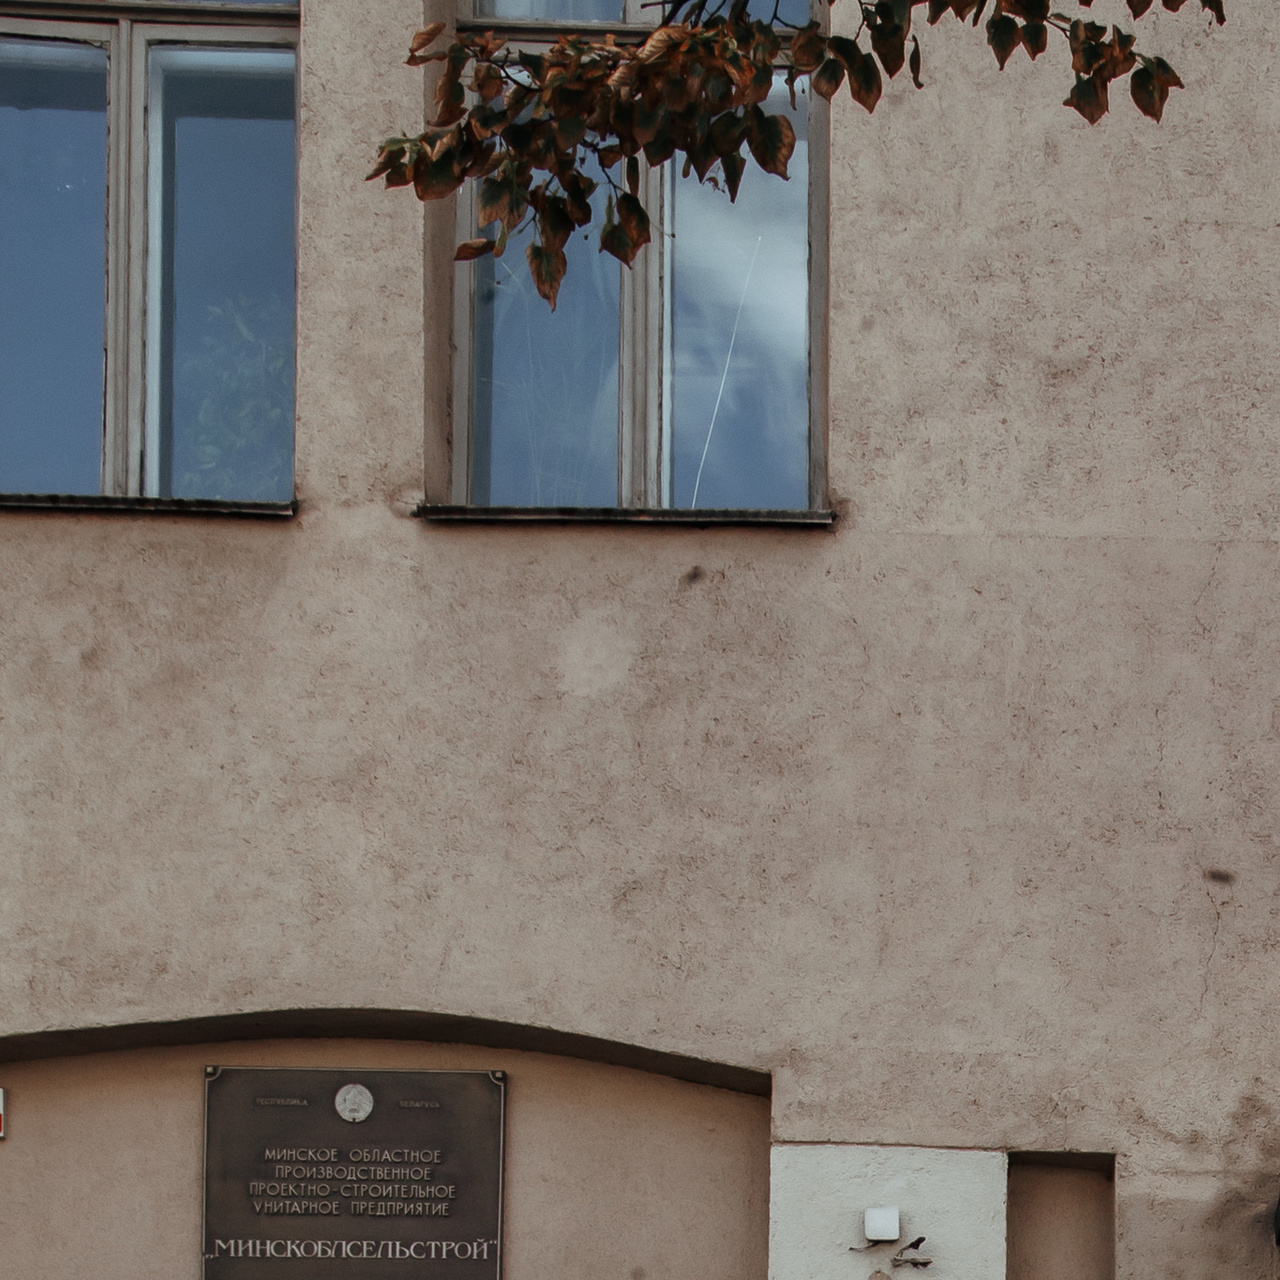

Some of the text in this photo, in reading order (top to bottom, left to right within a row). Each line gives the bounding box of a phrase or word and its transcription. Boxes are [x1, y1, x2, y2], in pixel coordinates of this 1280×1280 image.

[264, 1148, 442, 1163] МИНСКОЕ ОБЛАСТНОЕ
[275, 1165, 432, 1181] ПРОИЗВОДСТВЕННОЕ
[249, 1182, 456, 1199] ПРОЕКТНО-СТРОИТЕЛЬНОЕ
[253, 1201, 450, 1217] УНИТАРНОЕ ПРЕДПРИЯТИЕ
